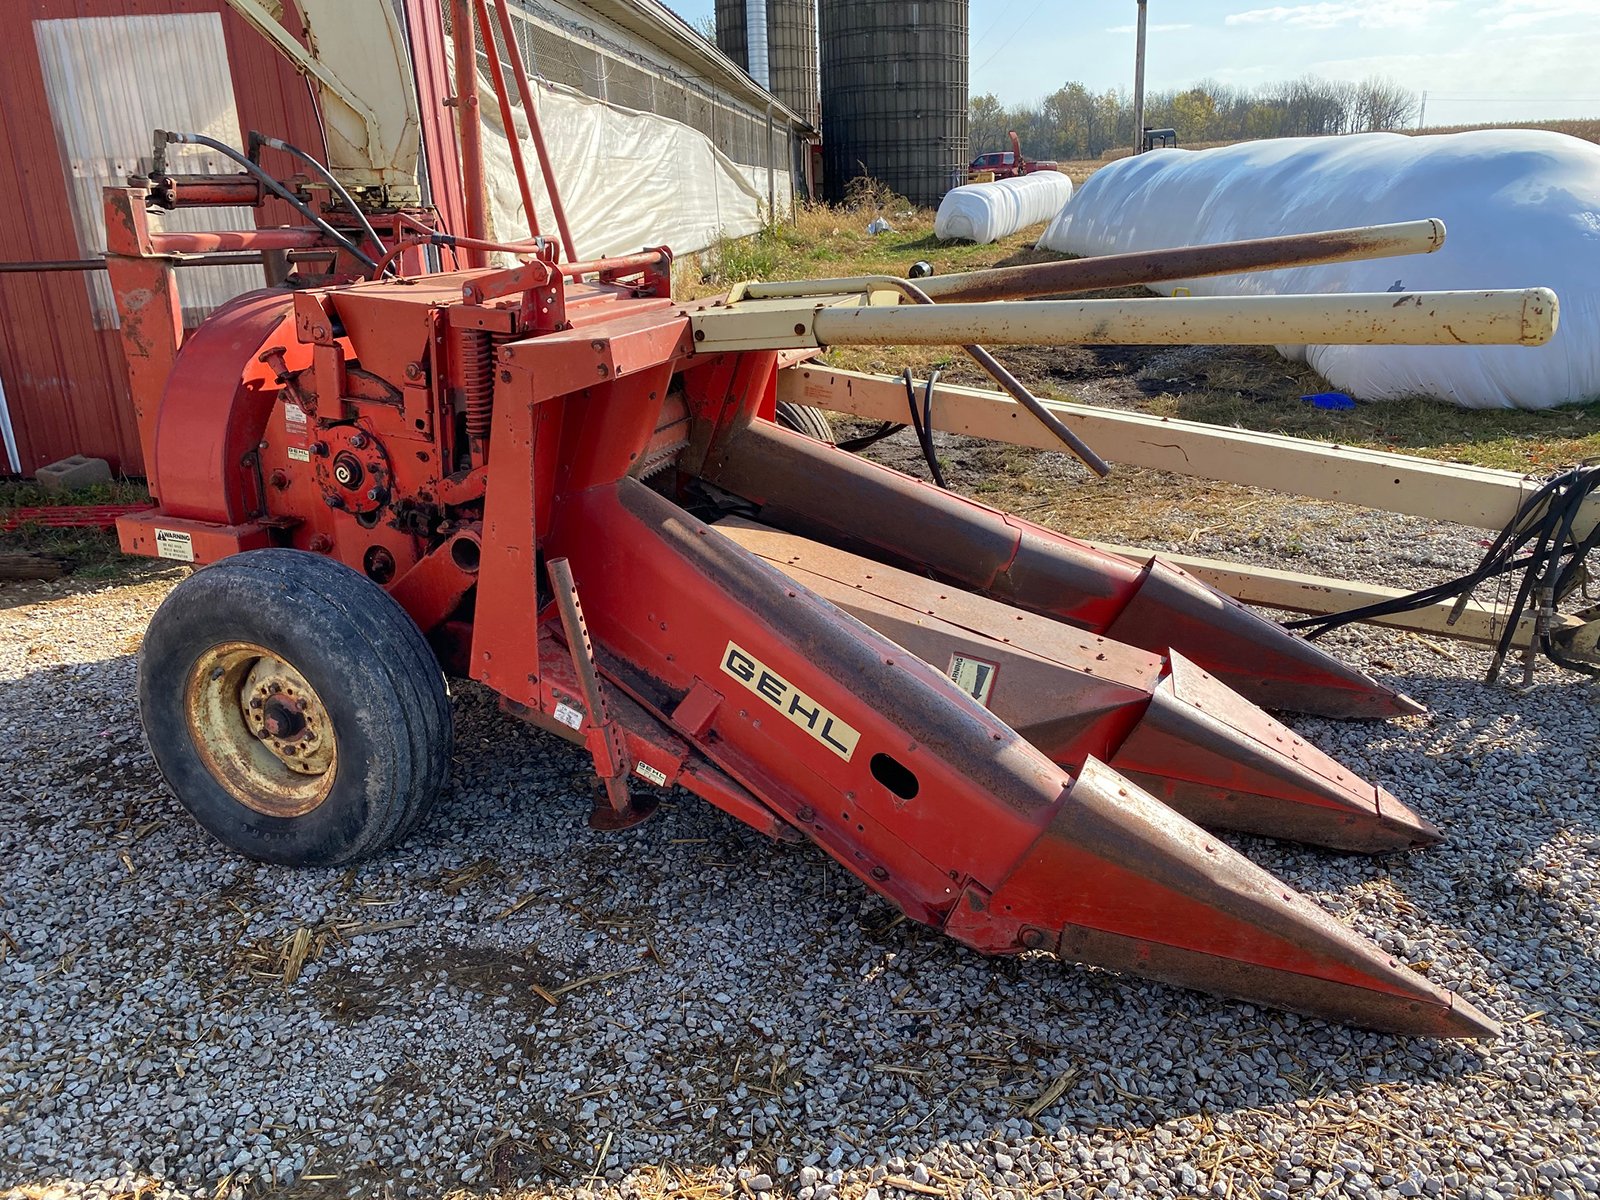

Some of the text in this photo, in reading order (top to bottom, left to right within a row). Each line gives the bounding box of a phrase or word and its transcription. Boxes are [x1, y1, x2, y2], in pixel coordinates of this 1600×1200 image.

[164, 532, 190, 541] WARNING
[951, 658, 963, 683] ARNING
[726, 649, 848, 754] GEHL
[639, 762, 664, 779] GEHL
